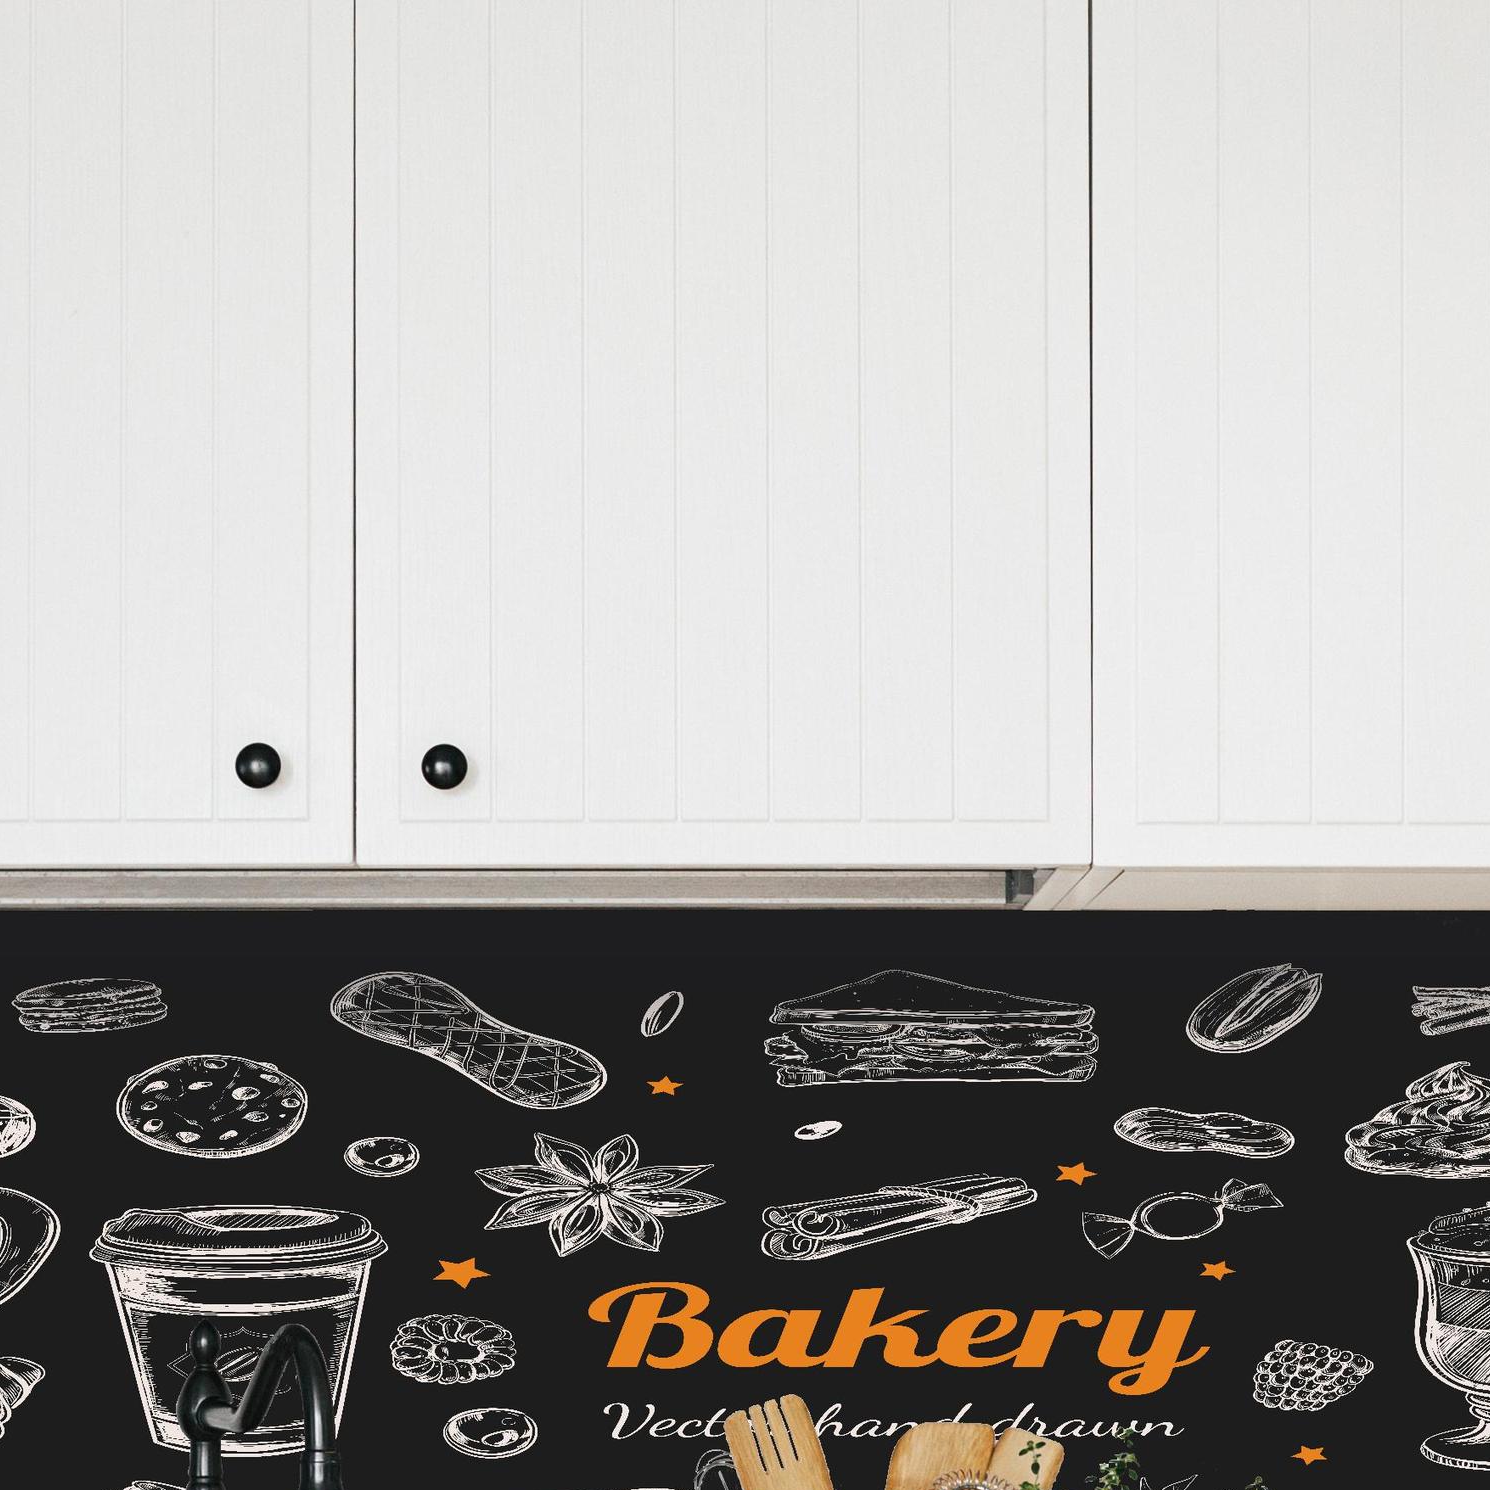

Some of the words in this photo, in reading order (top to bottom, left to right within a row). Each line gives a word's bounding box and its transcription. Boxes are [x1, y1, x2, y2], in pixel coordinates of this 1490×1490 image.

[588, 1281, 1210, 1396] Bakery
[603, 1402, 793, 1440] Vect
[993, 1402, 1186, 1439] drawn
